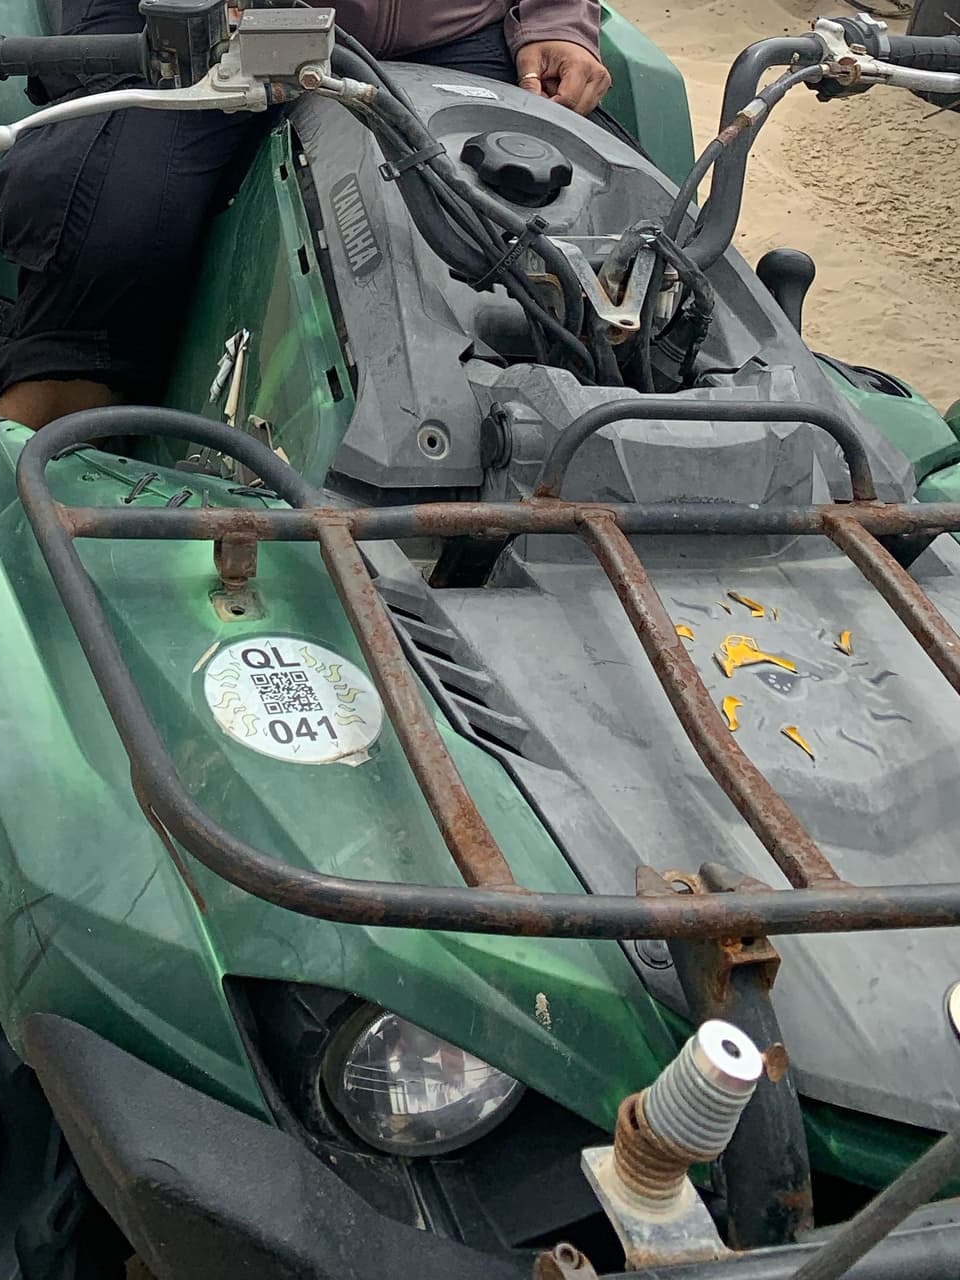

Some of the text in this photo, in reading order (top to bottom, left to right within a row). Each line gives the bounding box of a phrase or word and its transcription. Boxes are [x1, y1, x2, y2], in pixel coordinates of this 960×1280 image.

[333, 179, 378, 272] YAMAHA
[240, 646, 302, 671] QL
[268, 715, 339, 745] 041
